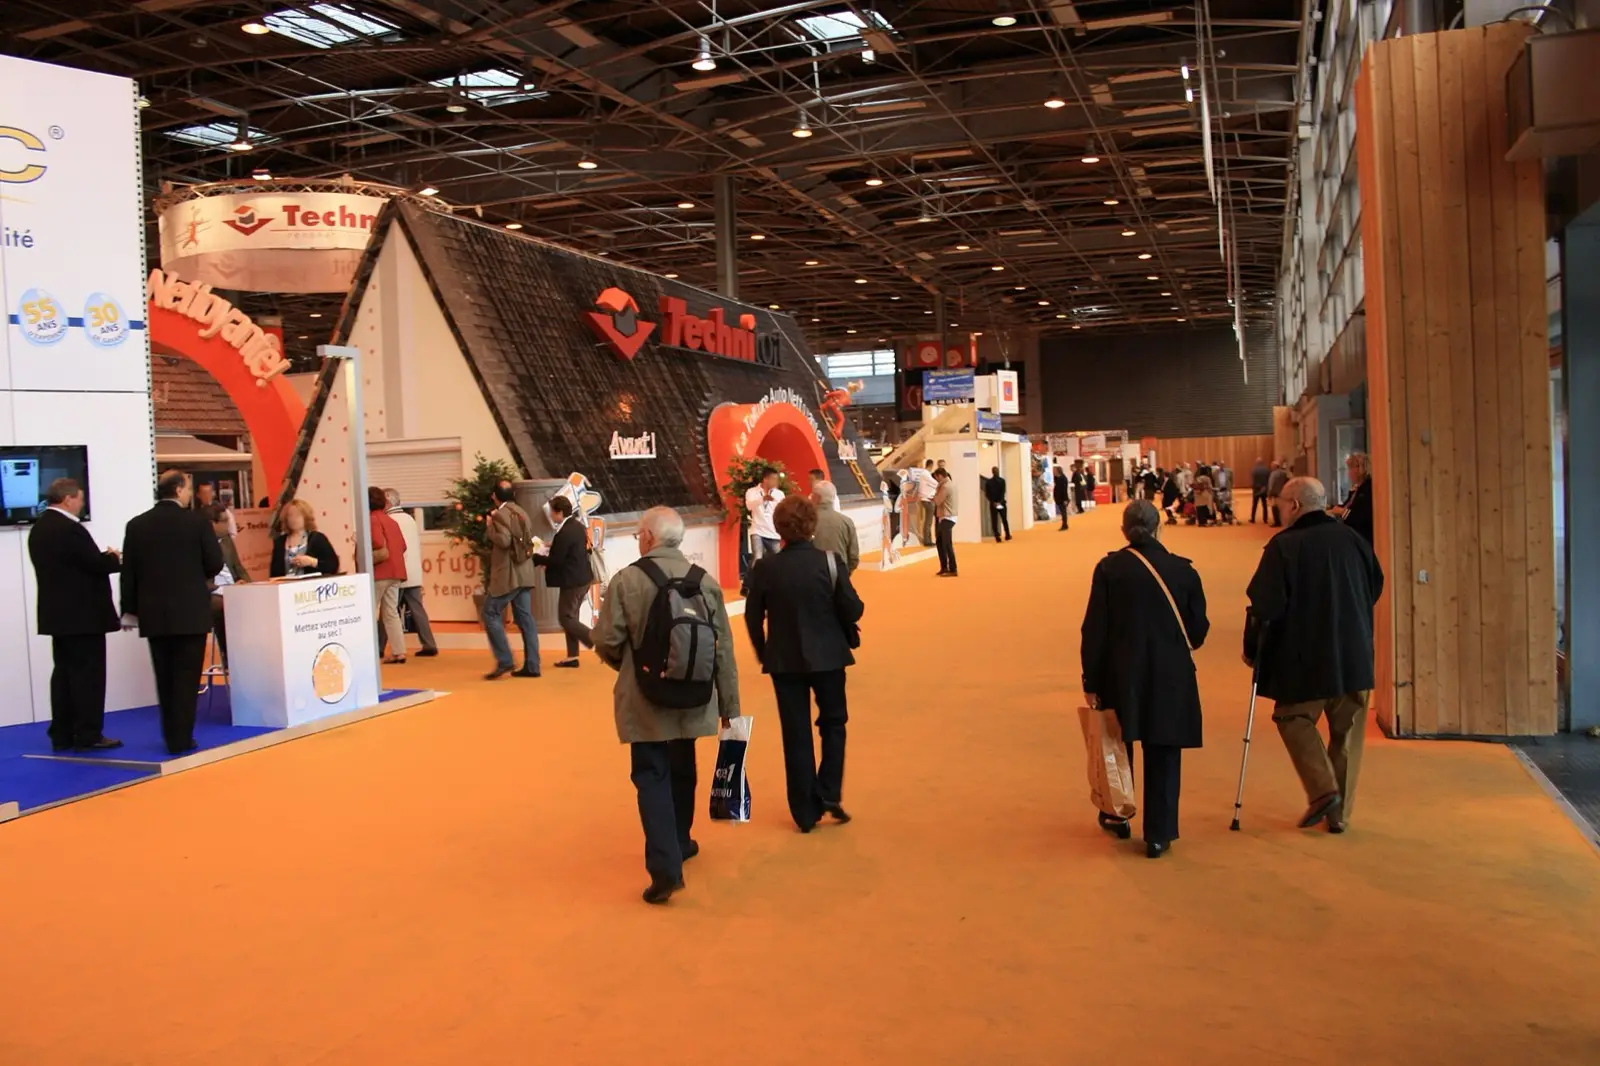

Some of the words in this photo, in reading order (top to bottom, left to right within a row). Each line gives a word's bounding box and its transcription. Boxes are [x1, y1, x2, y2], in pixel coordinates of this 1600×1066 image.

[0, 226, 34, 249] ité
[23, 298, 57, 325] 55
[88, 302, 119, 328] 30
[36, 319, 57, 331] ANS
[100, 323, 119, 334] ANS
[294, 622, 319, 633] Mettez
[320, 619, 338, 630] votre
[338, 615, 362, 626] maison
[317, 632, 327, 640] au
